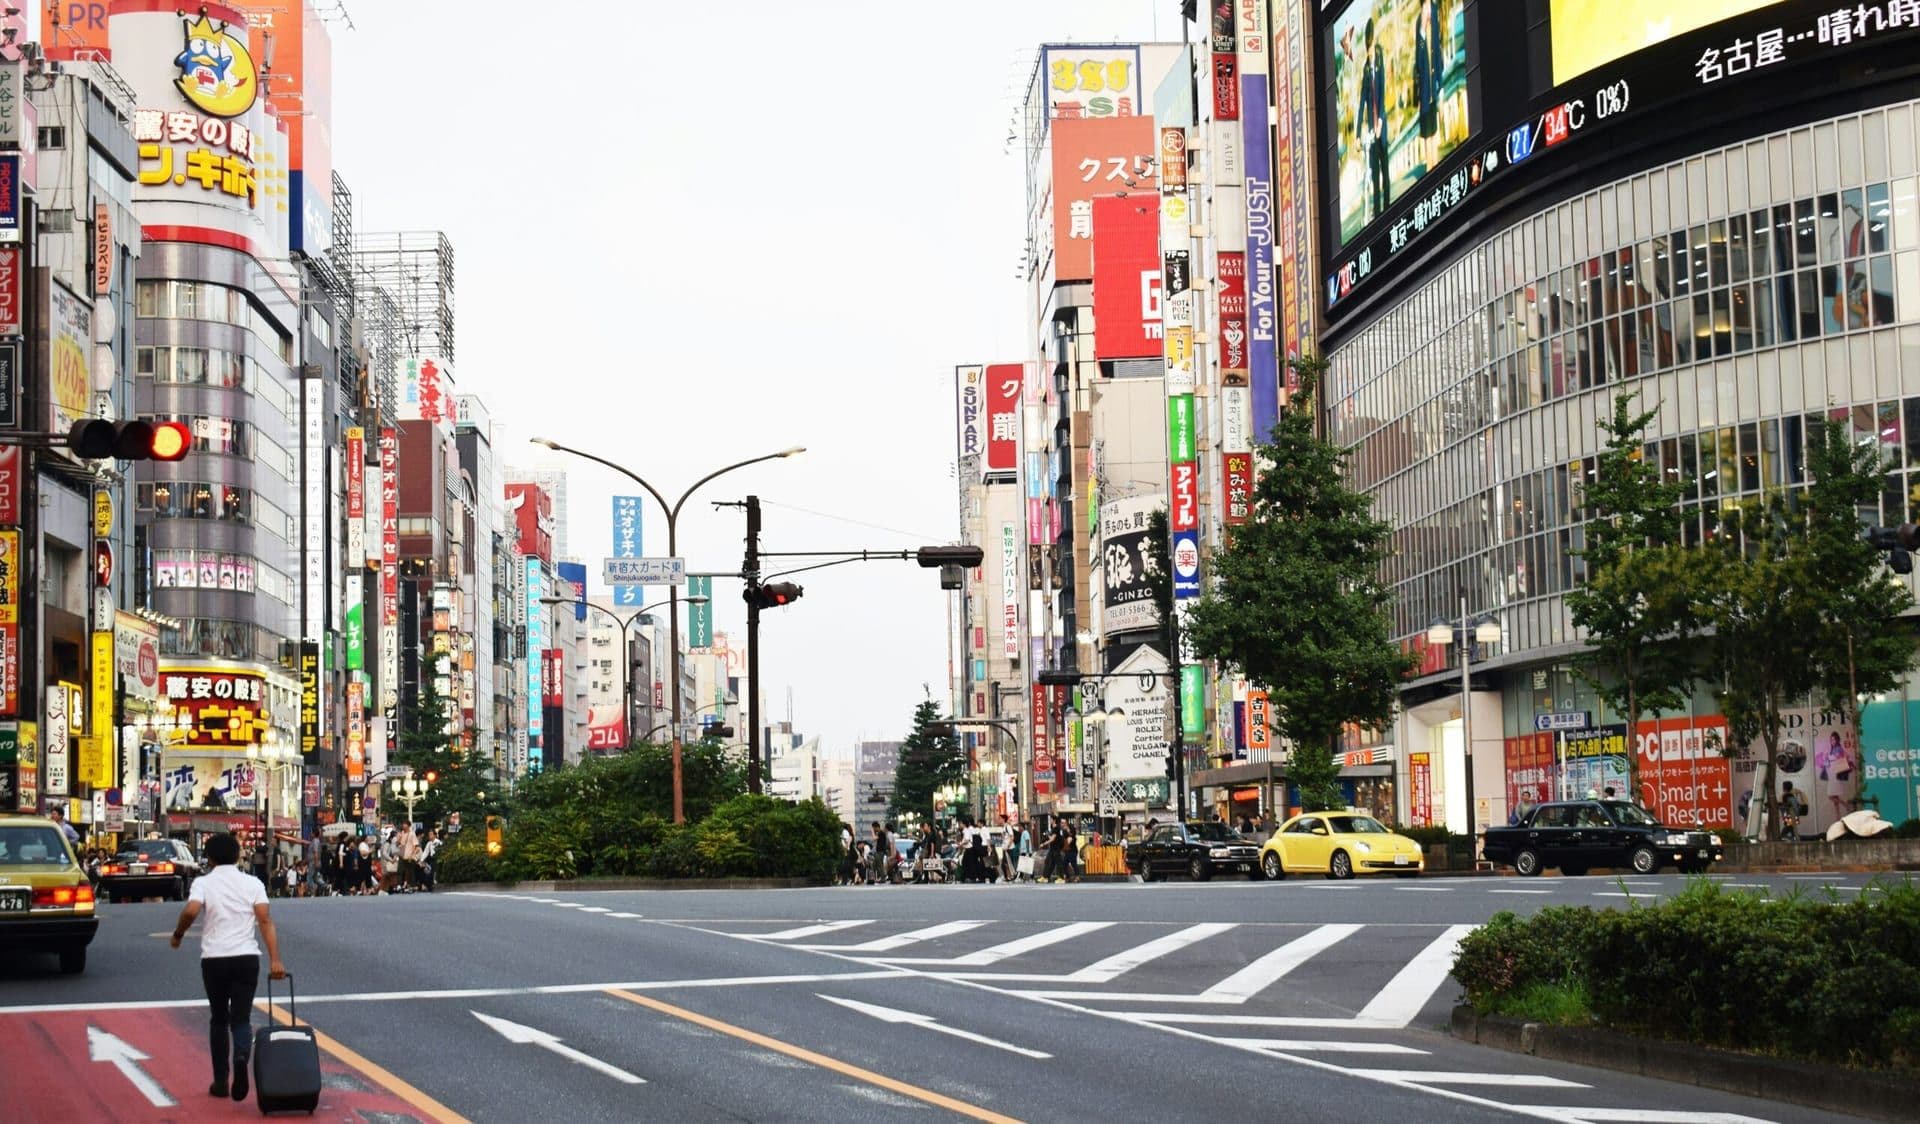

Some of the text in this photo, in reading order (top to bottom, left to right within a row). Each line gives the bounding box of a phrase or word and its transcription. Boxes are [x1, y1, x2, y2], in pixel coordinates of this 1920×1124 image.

[68, 4, 105, 29] PR
[1595, 79, 1630, 118] 0%)
[1079, 157, 1154, 182] クスリ
[1220, 258, 1242, 267] FAST
[1221, 267, 1243, 276] NAIL
[1253, 262, 1271, 305] Your
[1221, 296, 1243, 305] FAST
[1222, 305, 1244, 314] NAIL
[1285, 261, 1296, 344] FREE
[1254, 313, 1272, 340] For
[1001, 380, 1019, 398] ク
[964, 386, 977, 453] SUNPARK
[1177, 467, 1194, 525] アイフル
[1229, 458, 1248, 518] 飲み放題
[608, 561, 681, 574] 新宿大ガード東
[1004, 526, 1014, 599] 新宿サンパーク
[1178, 549, 1197, 567] 薬
[590, 729, 621, 745] コム
[1133, 751, 1167, 759] CHANEL
[1659, 782, 1708, 803] Smart
[1667, 805, 1728, 825] Rescue
